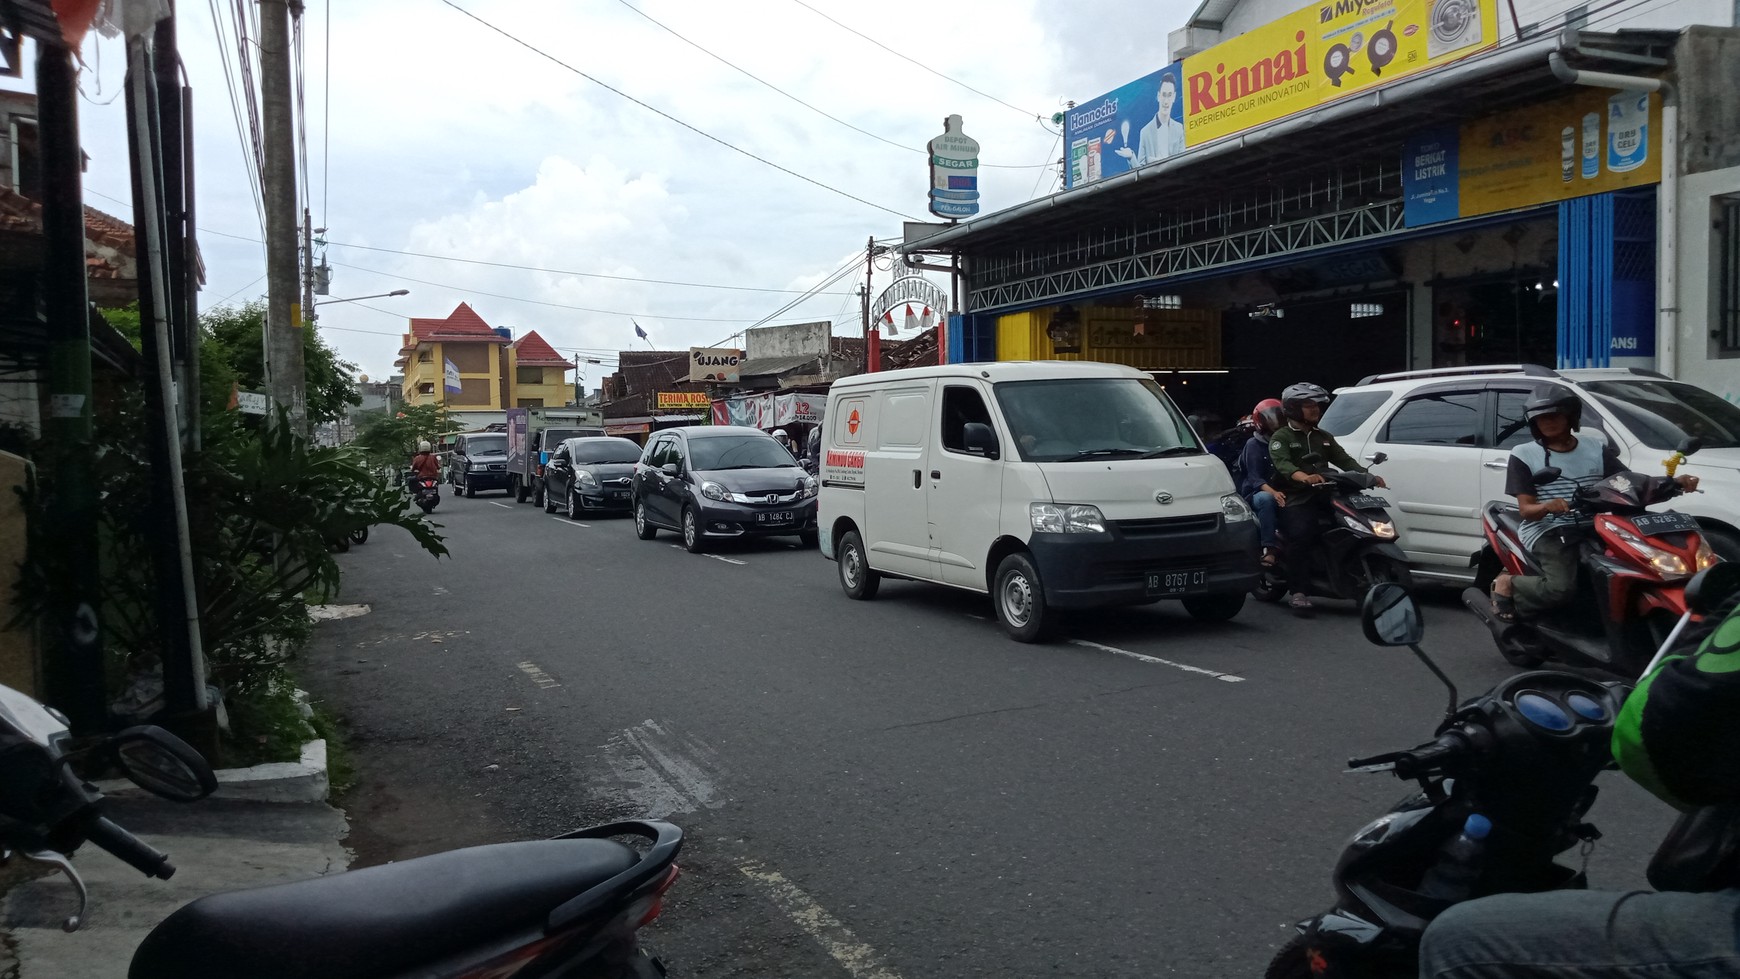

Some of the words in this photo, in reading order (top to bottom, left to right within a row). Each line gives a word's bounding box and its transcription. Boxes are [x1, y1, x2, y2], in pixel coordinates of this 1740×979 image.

[1187, 30, 1310, 117] Rinnai
[1189, 106, 1237, 130] EXPERIENCE
[1237, 99, 1256, 114] OUR
[1257, 79, 1311, 106] INNOVATION
[1070, 98, 1118, 131] Hannochs
[944, 136, 967, 144] DEPOT
[1618, 129, 1637, 140] DRY
[936, 143, 949, 151] AIR
[950, 144, 977, 153] MINUM
[1617, 140, 1637, 149] CELL
[938, 158, 973, 168] SEGAR
[1415, 150, 1446, 168] BERKAT
[1415, 164, 1446, 181] LISTRIK
[697, 355, 738, 367] UJANG
[659, 393, 690, 404] TERIMA
[795, 402, 810, 415] 12
[758, 513, 766, 522] AB
[785, 512, 793, 520] CJ
[1635, 517, 1650, 527] AB
[1652, 514, 1677, 524] 6285
[1148, 575, 1159, 588] AB
[1165, 573, 1188, 587] 8767
[1193, 571, 1205, 584] CT
